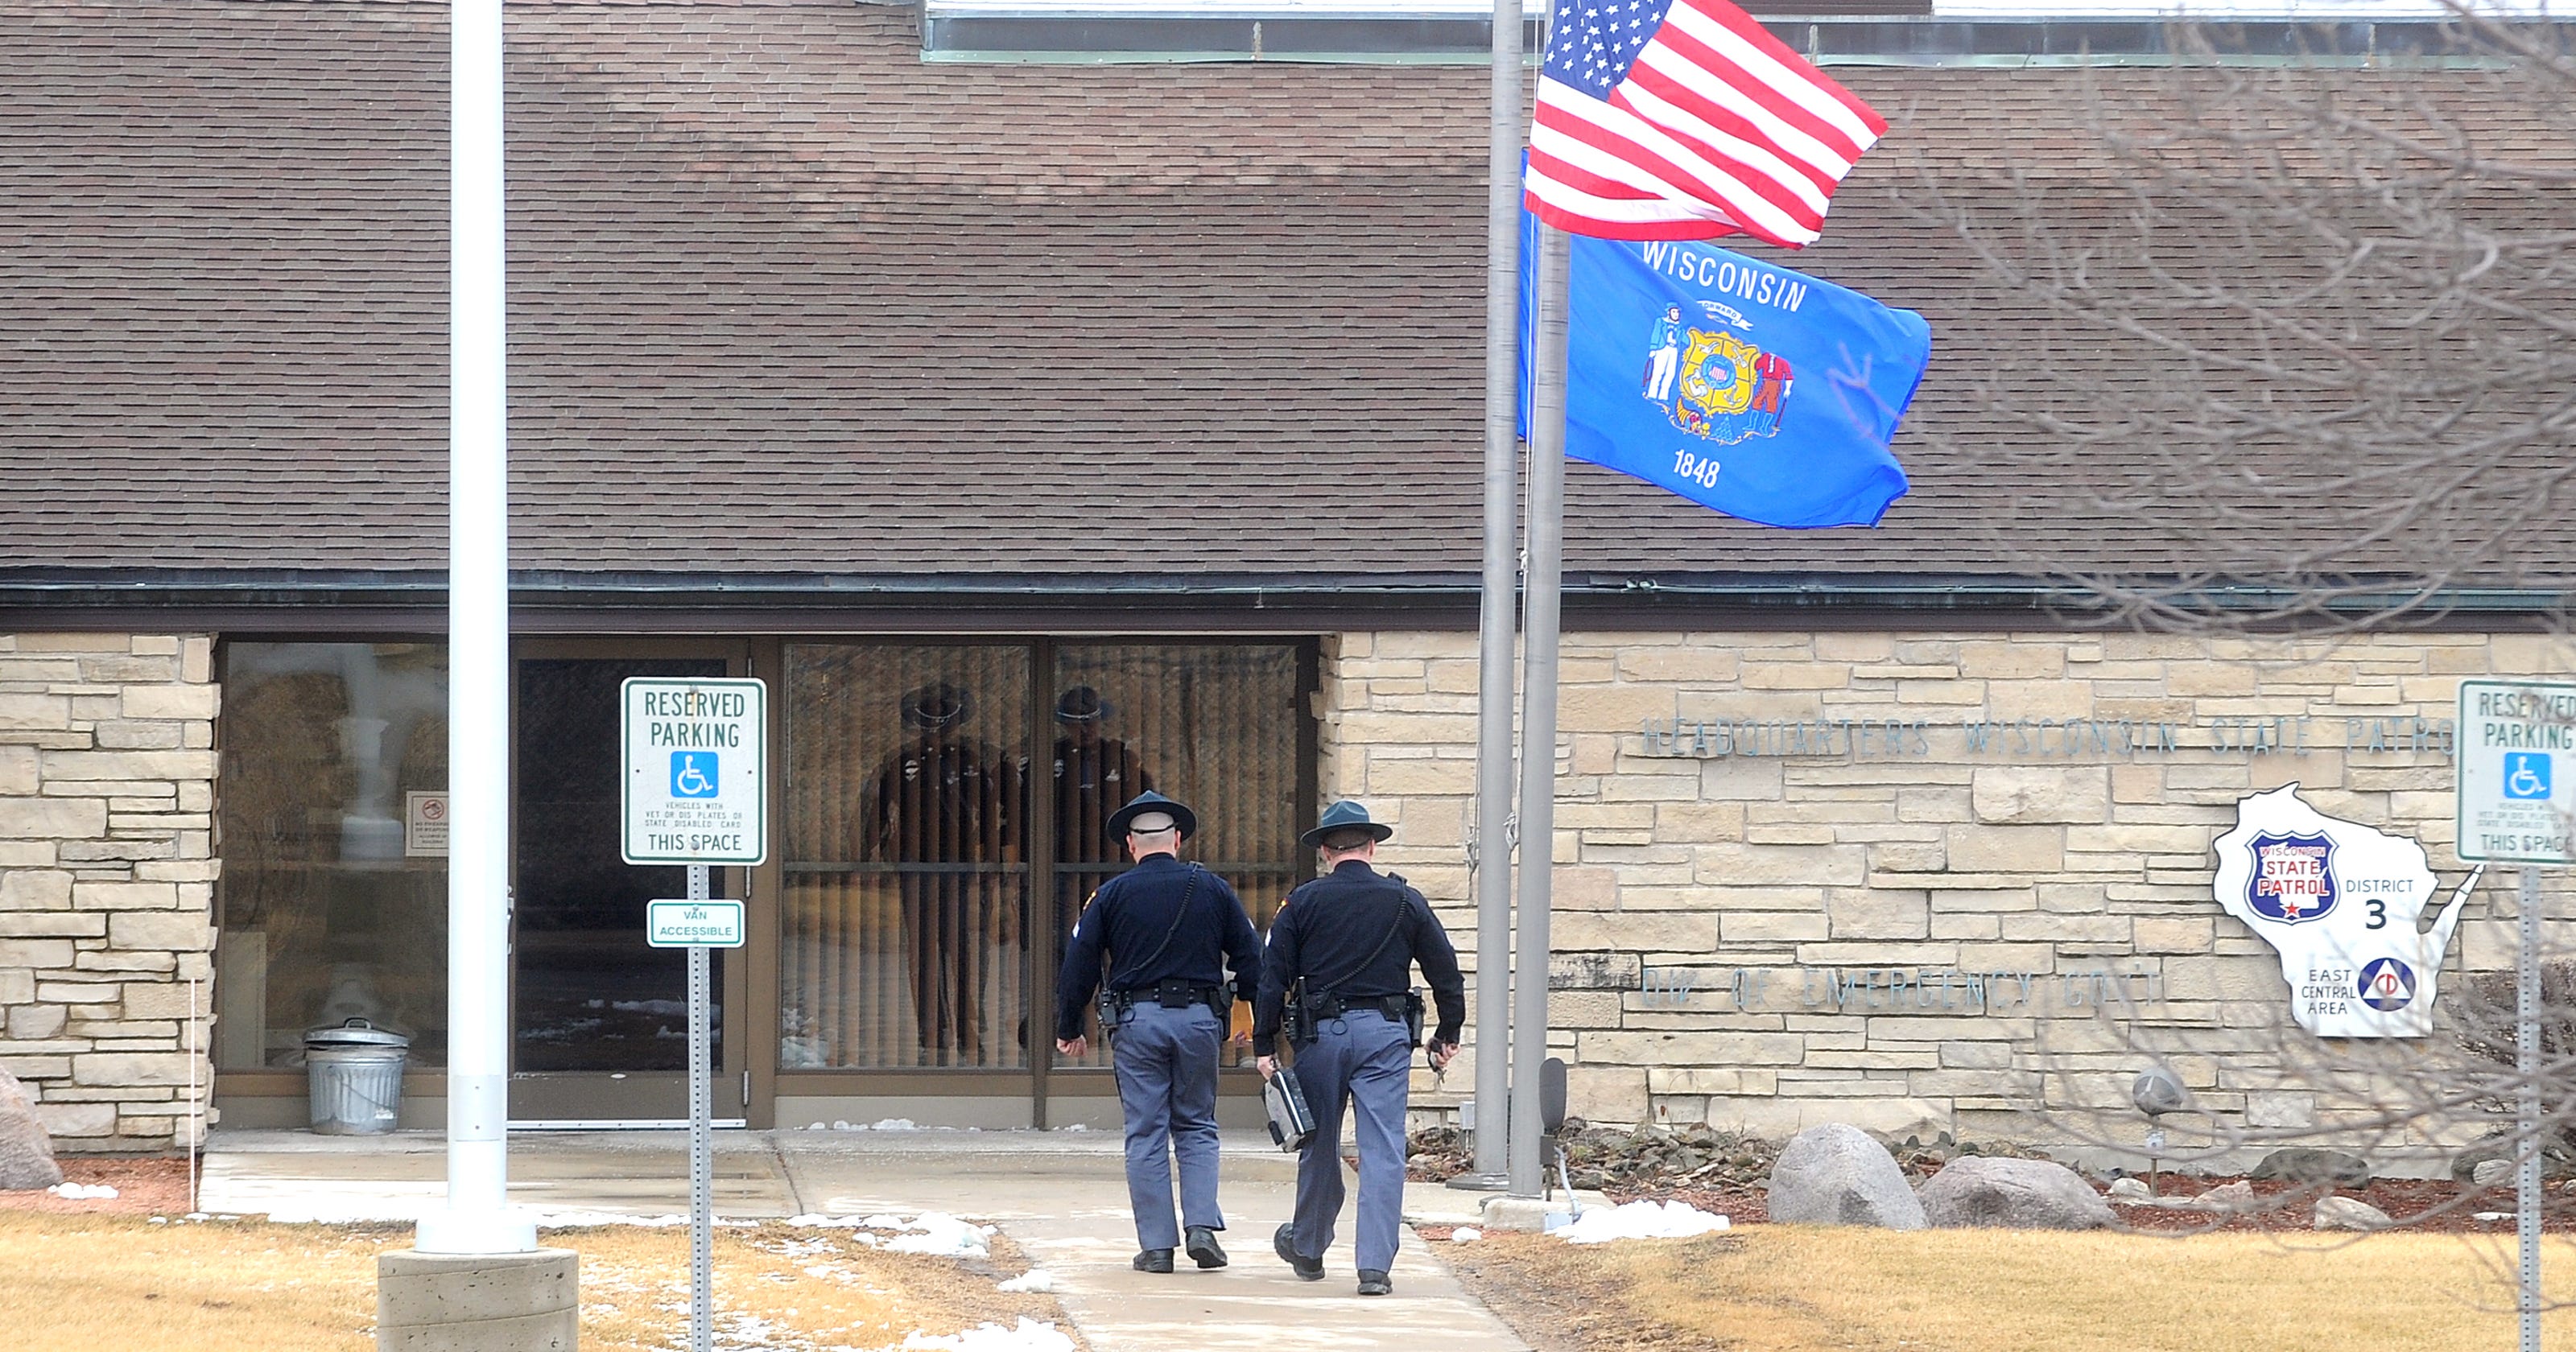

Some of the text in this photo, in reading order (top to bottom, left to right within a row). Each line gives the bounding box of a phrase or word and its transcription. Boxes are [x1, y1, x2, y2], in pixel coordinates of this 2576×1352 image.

[1643, 241, 1808, 312] WISCONSIN
[1703, 302, 1737, 318] ORWARD
[1674, 449, 1720, 488] 1848
[645, 692, 745, 718] RESERVED
[651, 723, 739, 748] PARKING
[1642, 716, 2454, 756] HEADQUARTERS WISCONSIN STATE PATRO
[2485, 723, 2573, 749] PARKING
[666, 802, 723, 810] VEHICLES WITH
[646, 810, 659, 818] VET
[697, 811, 727, 819] PLATES
[645, 819, 667, 827] STATE
[675, 820, 712, 828] DISABLED
[648, 834, 742, 851] THIS SPACE
[2480, 834, 2517, 851] THIS
[2260, 847, 2326, 856] WISCONSIN
[2266, 861, 2320, 875] STATE
[2259, 880, 2329, 894] PATROL
[2346, 880, 2413, 892] DISTRICT
[683, 911, 707, 920] VAN
[2365, 899, 2387, 930] 3
[659, 926, 733, 937] ACCESSIBLE
[2310, 970, 2351, 982] EAST
[1732, 967, 1771, 1007] OF
[1803, 968, 2032, 1007] EMERGENCY
[2301, 986, 2356, 999] CENTRAL
[2308, 1002, 2347, 1015] AREA
